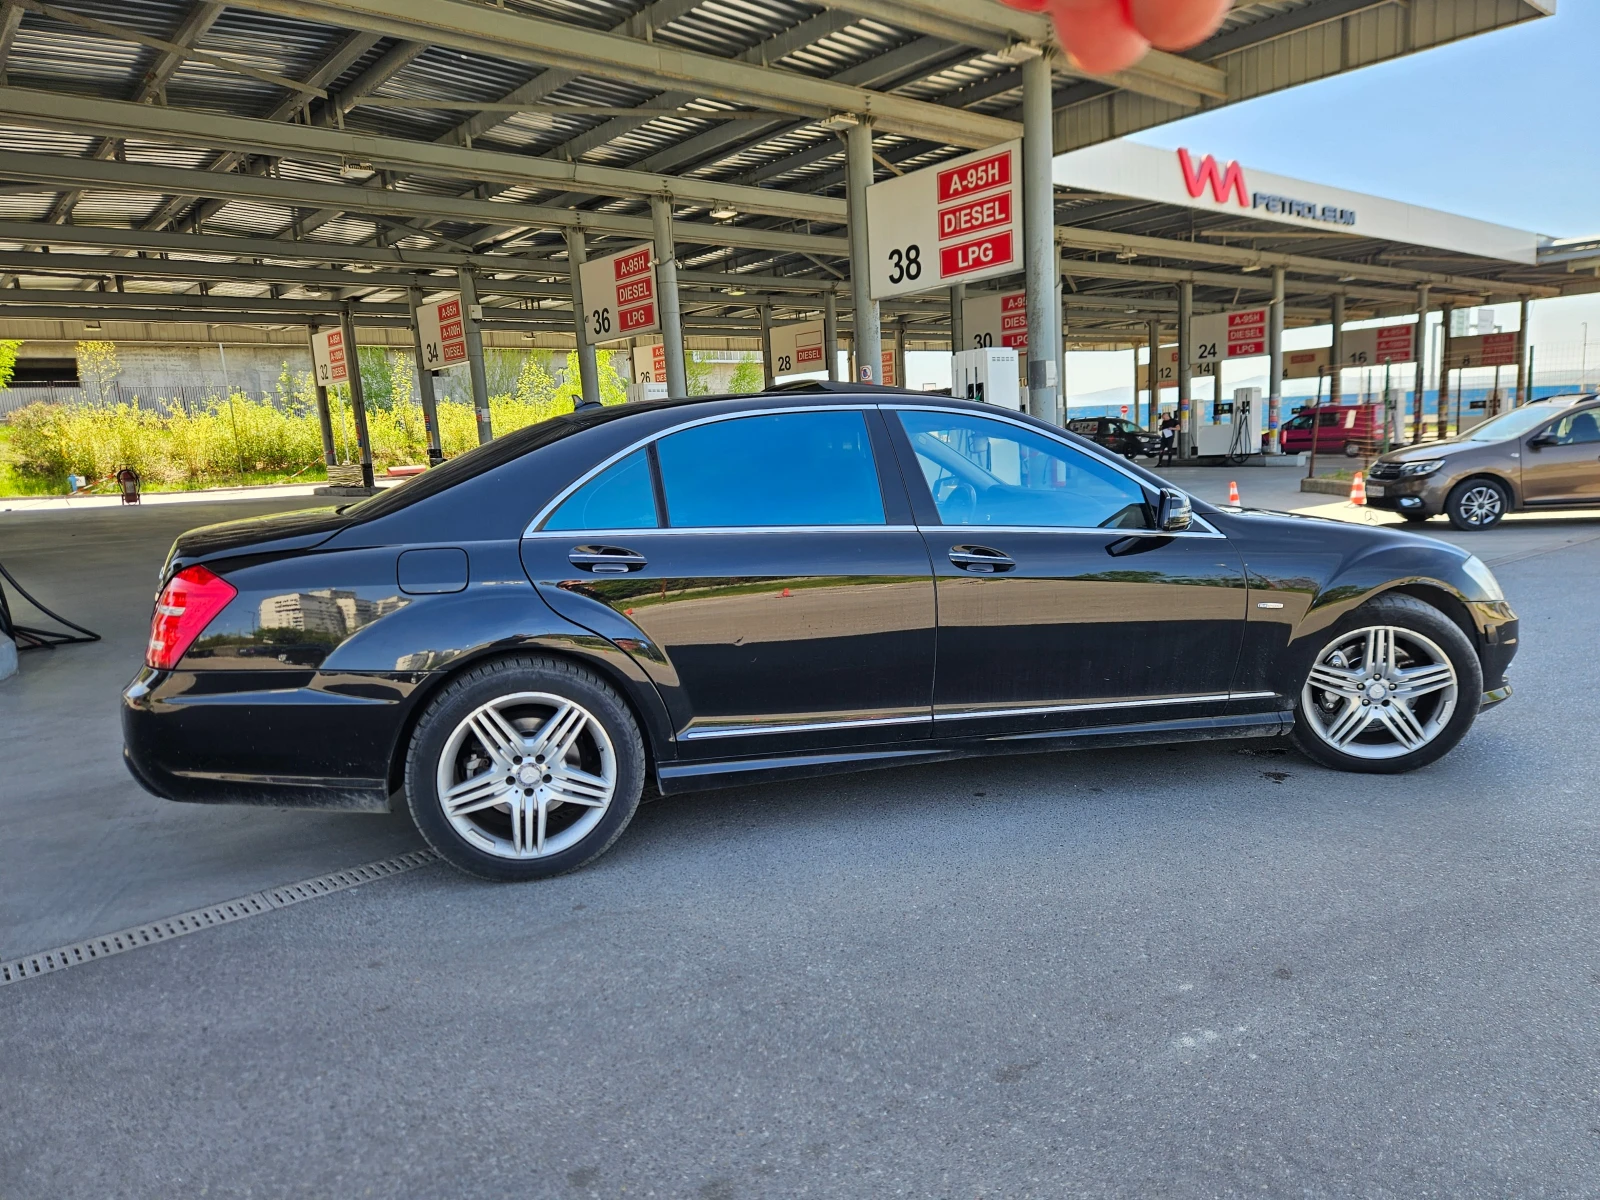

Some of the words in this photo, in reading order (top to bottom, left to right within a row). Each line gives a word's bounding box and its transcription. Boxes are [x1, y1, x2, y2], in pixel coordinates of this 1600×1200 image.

[949, 161, 999, 195] A-95H
[943, 201, 1006, 234] DIESEL
[1252, 192, 1356, 226] PETROLEUM
[957, 242, 993, 268] LPG
[620, 255, 645, 276] A-95H
[888, 244, 922, 285] 38
[619, 282, 649, 302] DIESEL
[441, 303, 457, 318] A-95H
[627, 309, 645, 326] LPG
[1233, 313, 1260, 325] A-95H
[592, 307, 611, 335] 36
[442, 324, 461, 339] A-100H
[1230, 328, 1262, 340] DIESEL
[973, 332, 993, 349] 30
[1235, 343, 1256, 354] LPG
[426, 342, 439, 363] 34
[444, 345, 464, 359] DIESEL
[798, 349, 821, 361] DIESEL
[1198, 342, 1218, 359] 24
[1349, 351, 1368, 365] 16
[319, 363, 329, 380] 32
[332, 366, 346, 377] DIESEL
[777, 355, 792, 372] 28
[1196, 363, 1211, 375] 14
[640, 371, 651, 383] 26
[1158, 366, 1172, 379] 12
